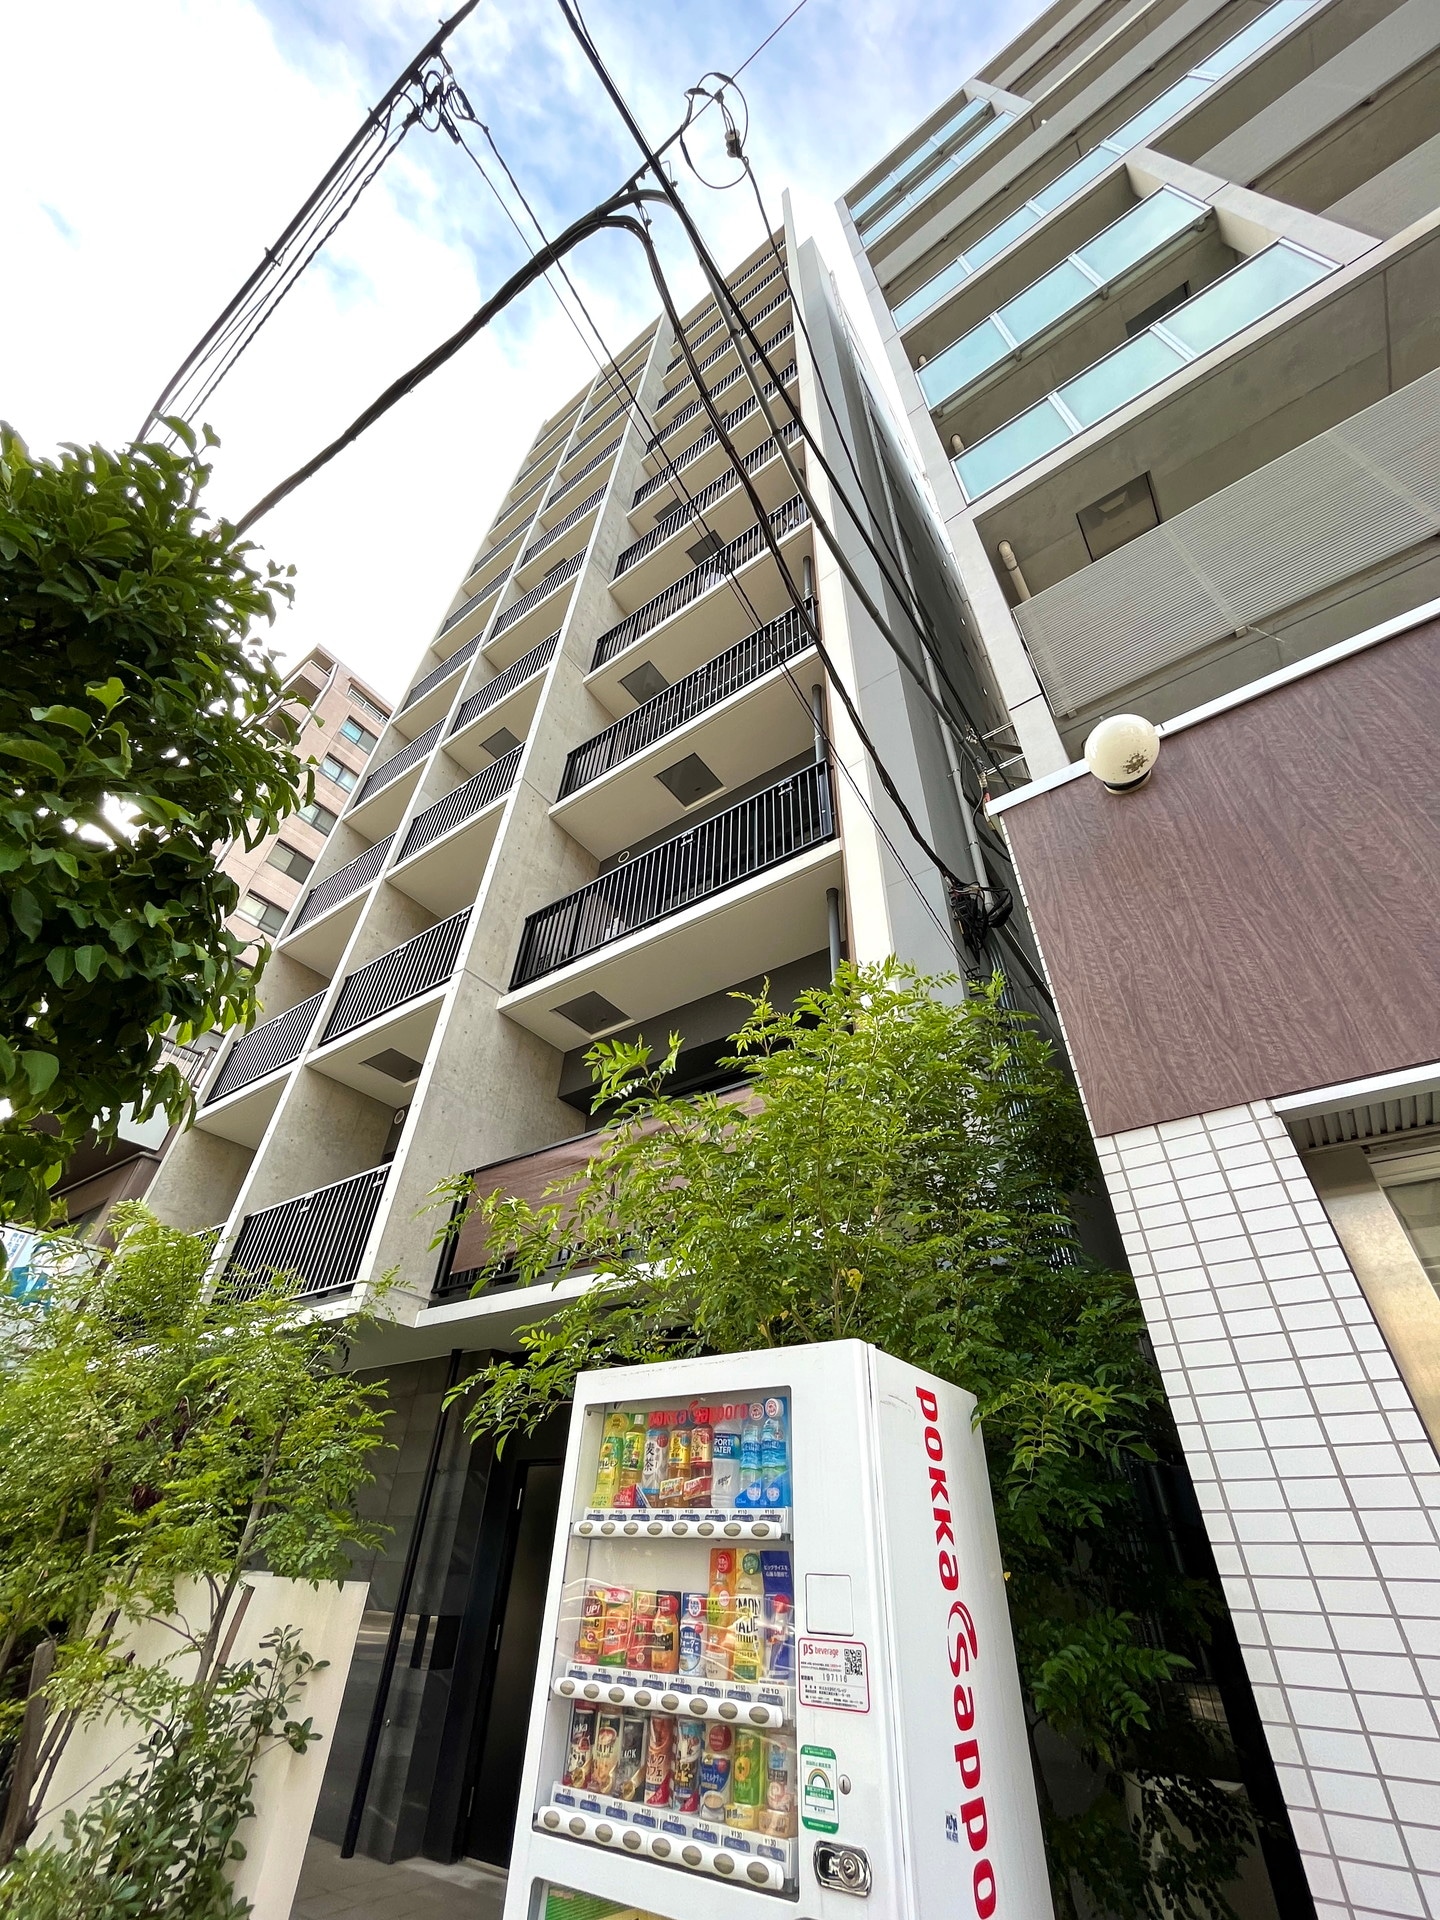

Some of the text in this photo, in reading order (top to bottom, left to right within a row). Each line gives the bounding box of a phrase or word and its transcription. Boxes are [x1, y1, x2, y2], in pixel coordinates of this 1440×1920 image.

[714, 1437, 734, 1447] PORTS
[644, 1441, 655, 1472] 麦茶
[814, 1646, 839, 1658] beverage
[822, 1672, 848, 1683] 197116
[731, 1830, 742, 1839] ¥130
